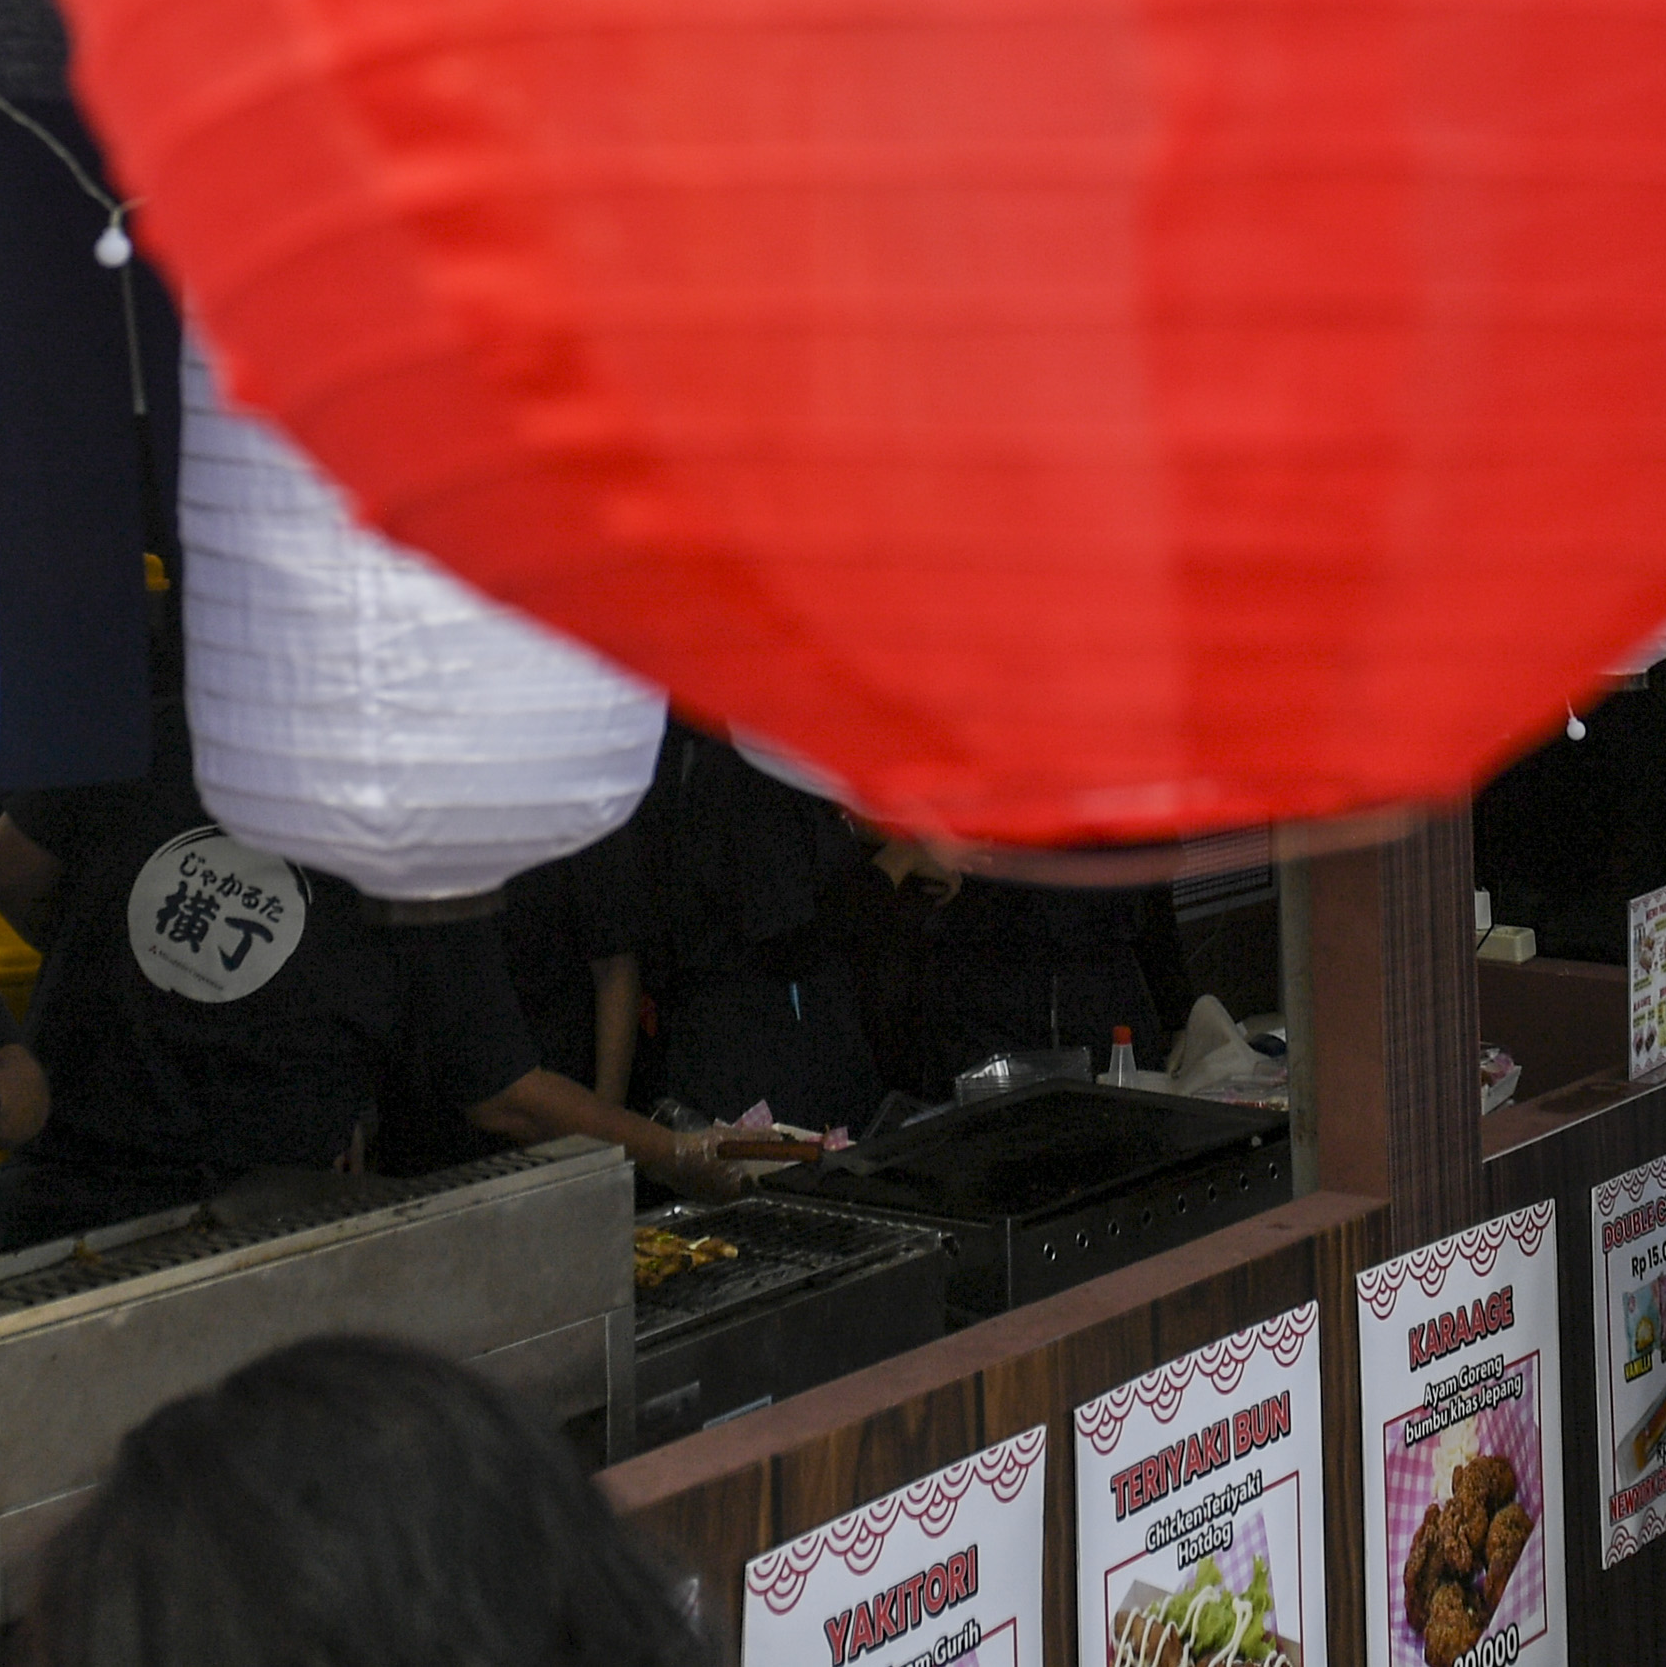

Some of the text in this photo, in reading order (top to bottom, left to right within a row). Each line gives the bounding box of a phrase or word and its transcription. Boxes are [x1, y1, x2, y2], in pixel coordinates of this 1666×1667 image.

[179, 851, 285, 924] じゃかるた
[155, 880, 275, 972] 横丁
[1602, 1201, 1655, 1253] DOUBLE
[1631, 1254, 1647, 1281] Rp
[1408, 1284, 1515, 1373] KARAAGE
[1403, 1372, 1524, 1447] bumbu khas Jepang
[1423, 1353, 1505, 1409] Ayam Goreng
[1110, 1390, 1292, 1523] TERIYAKI BUN
[1145, 1468, 1264, 1554] Chicken Teriyaki
[1177, 1520, 1234, 1570] Hotdog
[824, 1543, 978, 1667] YAKITORI
[932, 1618, 983, 1666] Gurih
